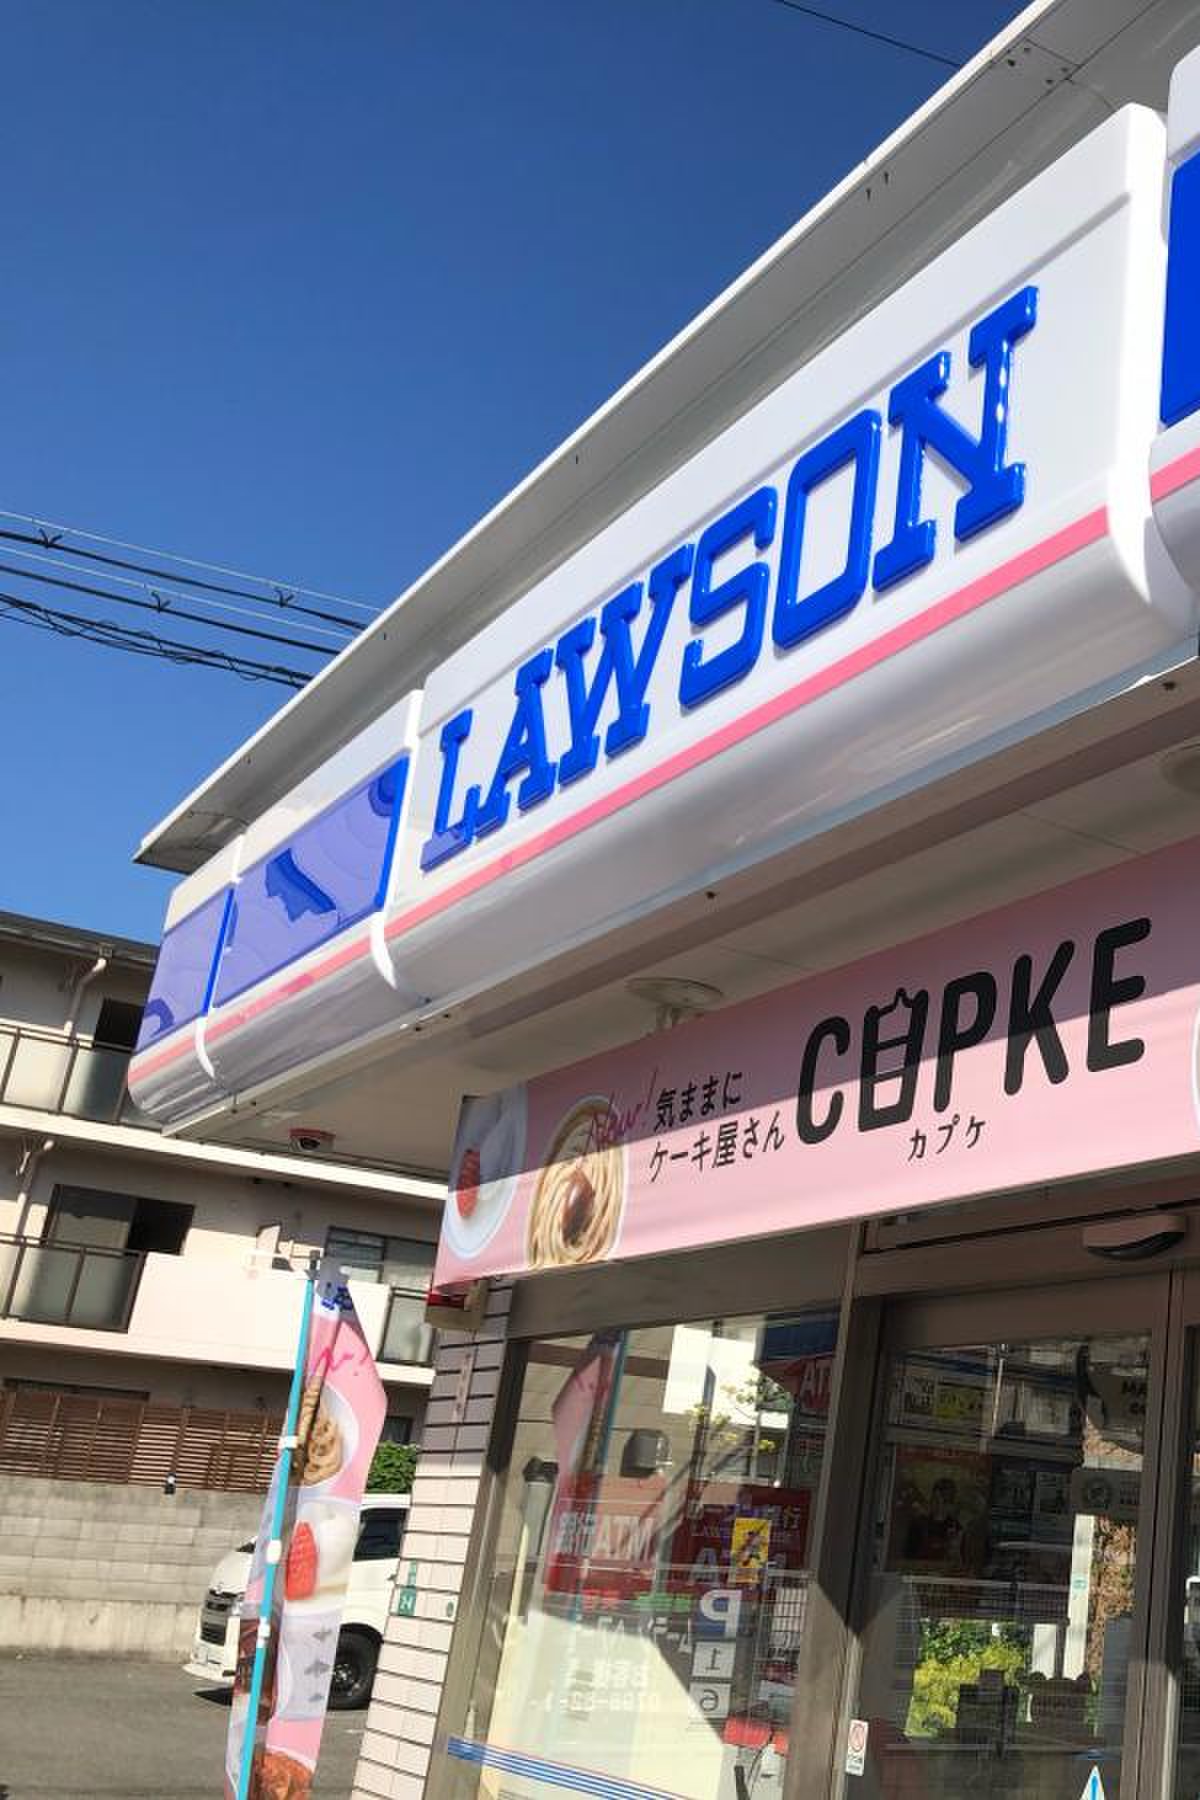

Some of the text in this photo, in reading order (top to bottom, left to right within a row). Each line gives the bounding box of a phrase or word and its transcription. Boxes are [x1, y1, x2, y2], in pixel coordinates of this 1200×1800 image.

[420, 285, 1039, 873] LAWSON
[796, 917, 1152, 1144] CUPKE
[654, 1071, 743, 1132] 気ままに
[907, 1113, 986, 1162] カプケ
[649, 1109, 785, 1183] ケーキ屋さん
